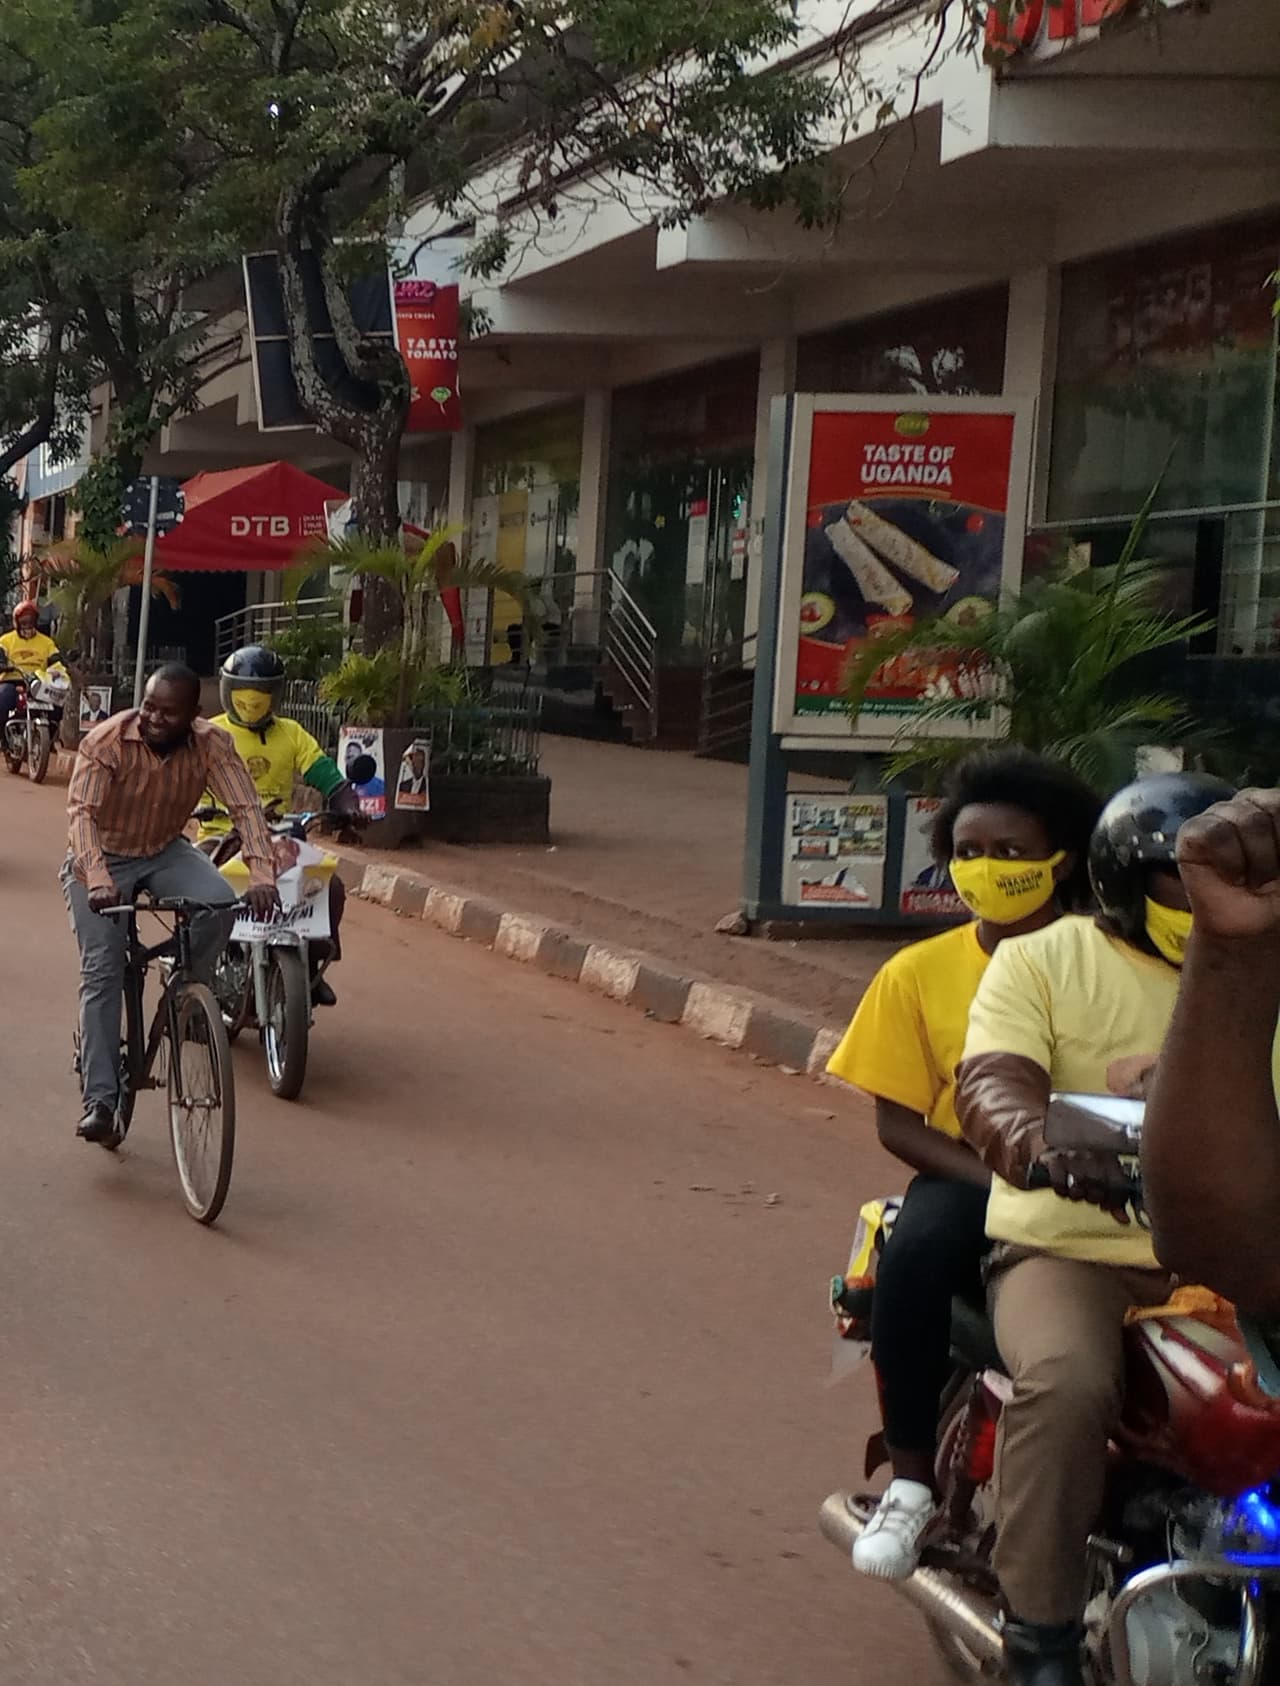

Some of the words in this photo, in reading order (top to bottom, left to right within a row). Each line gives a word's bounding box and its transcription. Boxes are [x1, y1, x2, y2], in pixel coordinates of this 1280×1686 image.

[407, 338, 456, 350] TASTY
[407, 350, 457, 360] TOMATO
[863, 444, 926, 463] TASTE
[928, 445, 955, 464] OF
[861, 464, 953, 486] UGANDA
[231, 516, 289, 536] DTB
